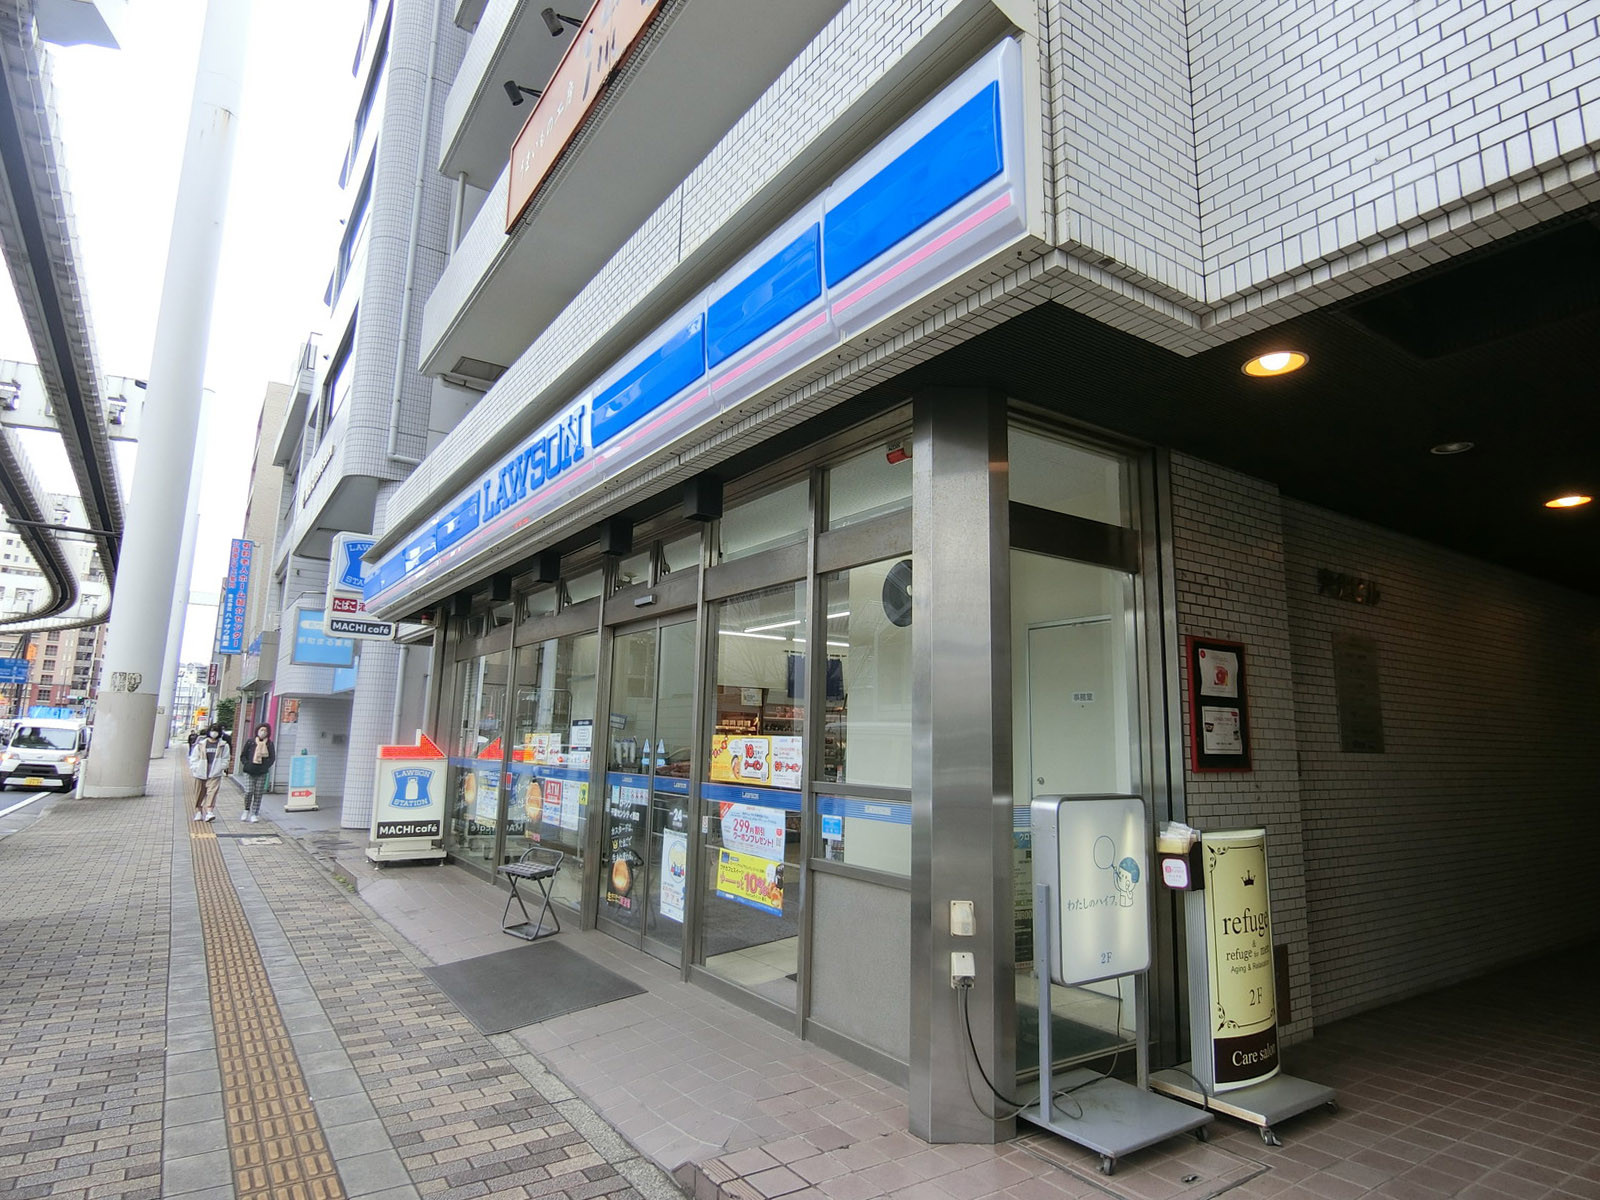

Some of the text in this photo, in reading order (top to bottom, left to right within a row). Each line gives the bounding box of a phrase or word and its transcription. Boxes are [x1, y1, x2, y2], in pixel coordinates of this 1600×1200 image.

[482, 404, 585, 522] LAWSON
[333, 599, 357, 612] たばこ
[332, 621, 367, 632] MACHI
[367, 624, 390, 634] café
[396, 770, 431, 778] LAWSON
[547, 783, 560, 795] ATM
[393, 799, 429, 807] STATION
[673, 808, 683, 821] 24
[379, 823, 438, 835] MACHI café
[733, 818, 764, 836] 299円割引
[1223, 907, 1269, 937] refuge
[1101, 951, 1113, 964] 2F
[1226, 947, 1253, 962] refuge
[1231, 964, 1247, 975] Aging
[1249, 986, 1263, 1007] 2F
[1232, 1050, 1258, 1067] Care
